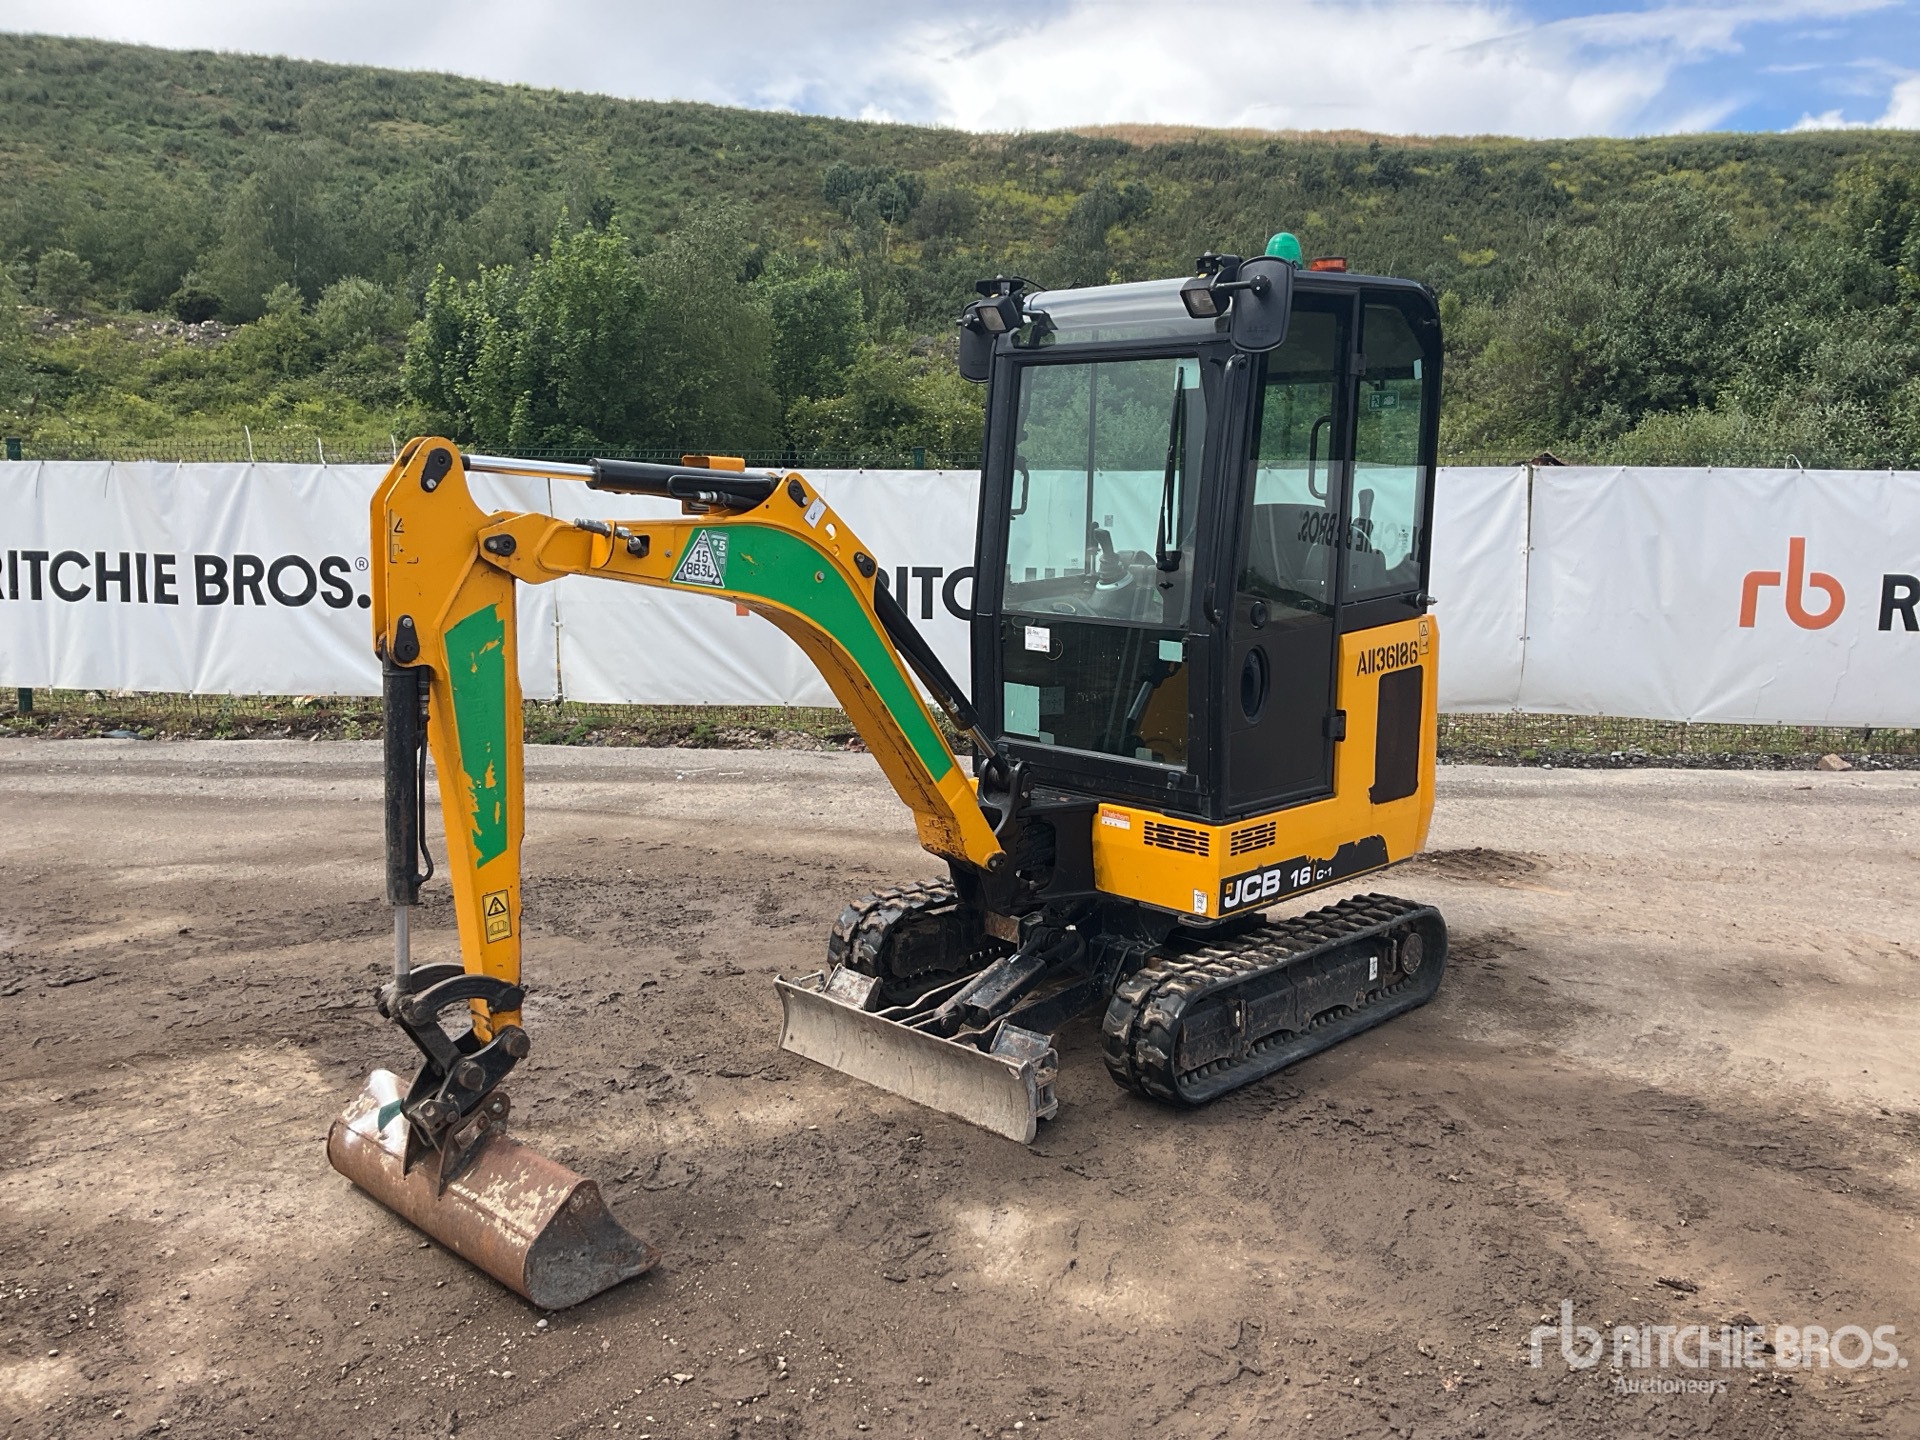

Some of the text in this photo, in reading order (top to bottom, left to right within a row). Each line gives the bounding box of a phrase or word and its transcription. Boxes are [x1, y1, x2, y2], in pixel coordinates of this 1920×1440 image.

[0, 550, 178, 605] ITCHIE
[687, 562, 714, 578] BB3L
[695, 550, 709, 563] 15
[878, 566, 974, 621] ITC
[1739, 537, 1845, 630] rb
[1224, 869, 1281, 908] JCB
[1290, 866, 1311, 887] 16
